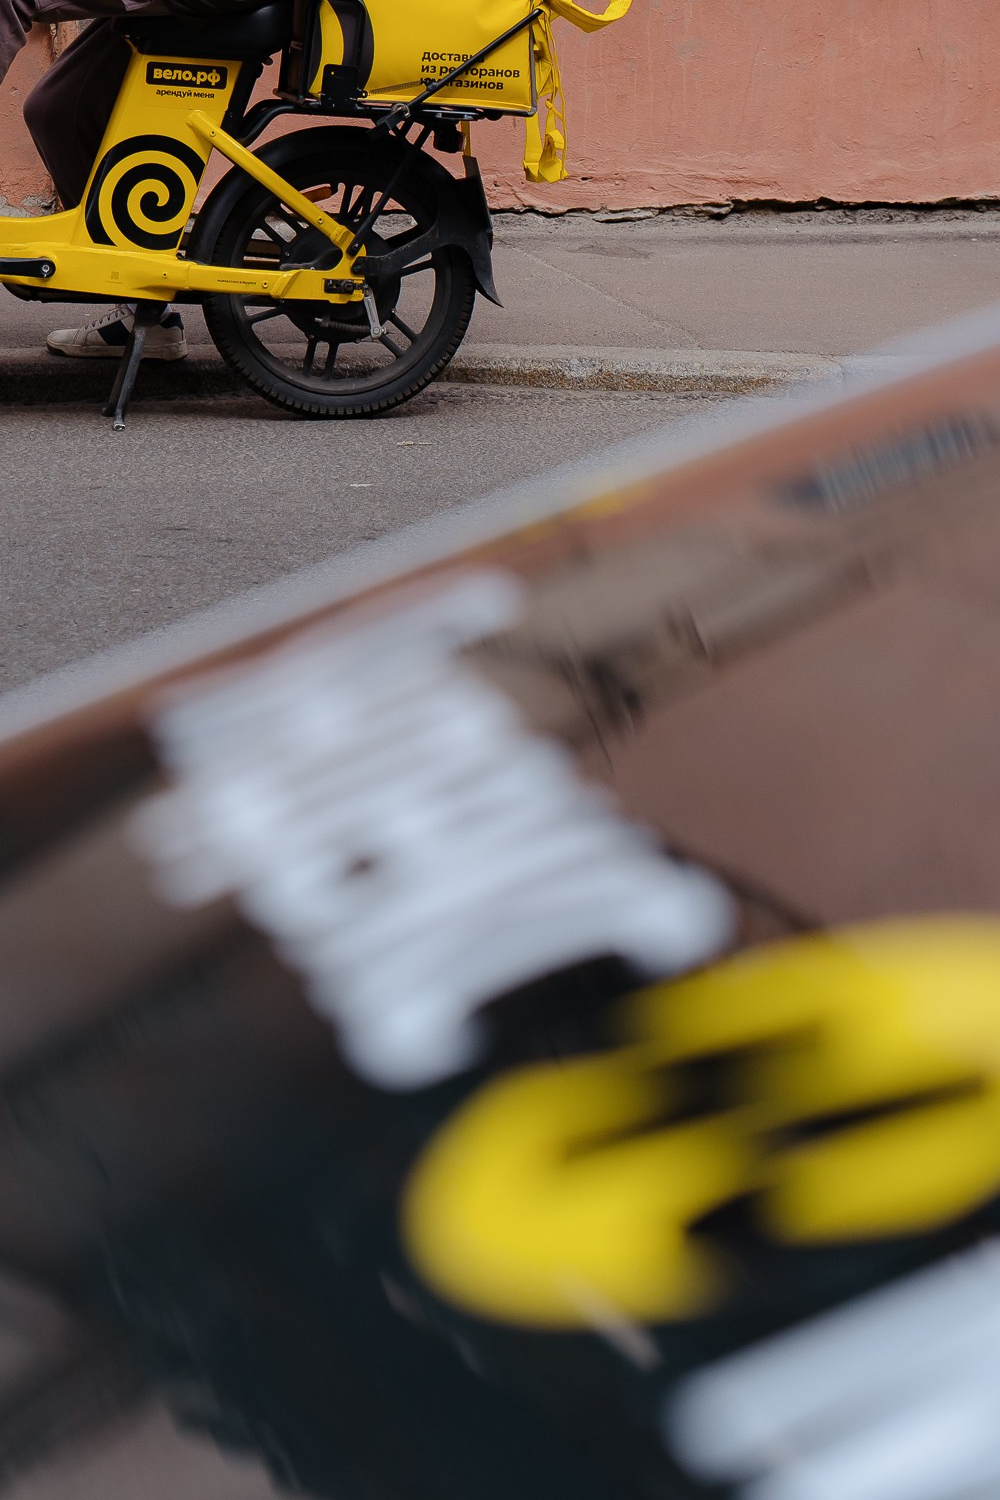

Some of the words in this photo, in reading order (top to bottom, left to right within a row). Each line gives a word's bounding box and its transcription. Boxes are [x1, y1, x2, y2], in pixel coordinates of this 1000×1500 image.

[420, 63, 437, 74] из
[153, 66, 221, 87] вело.рф
[155, 88, 192, 99] арендуй
[193, 90, 215, 100] меня
